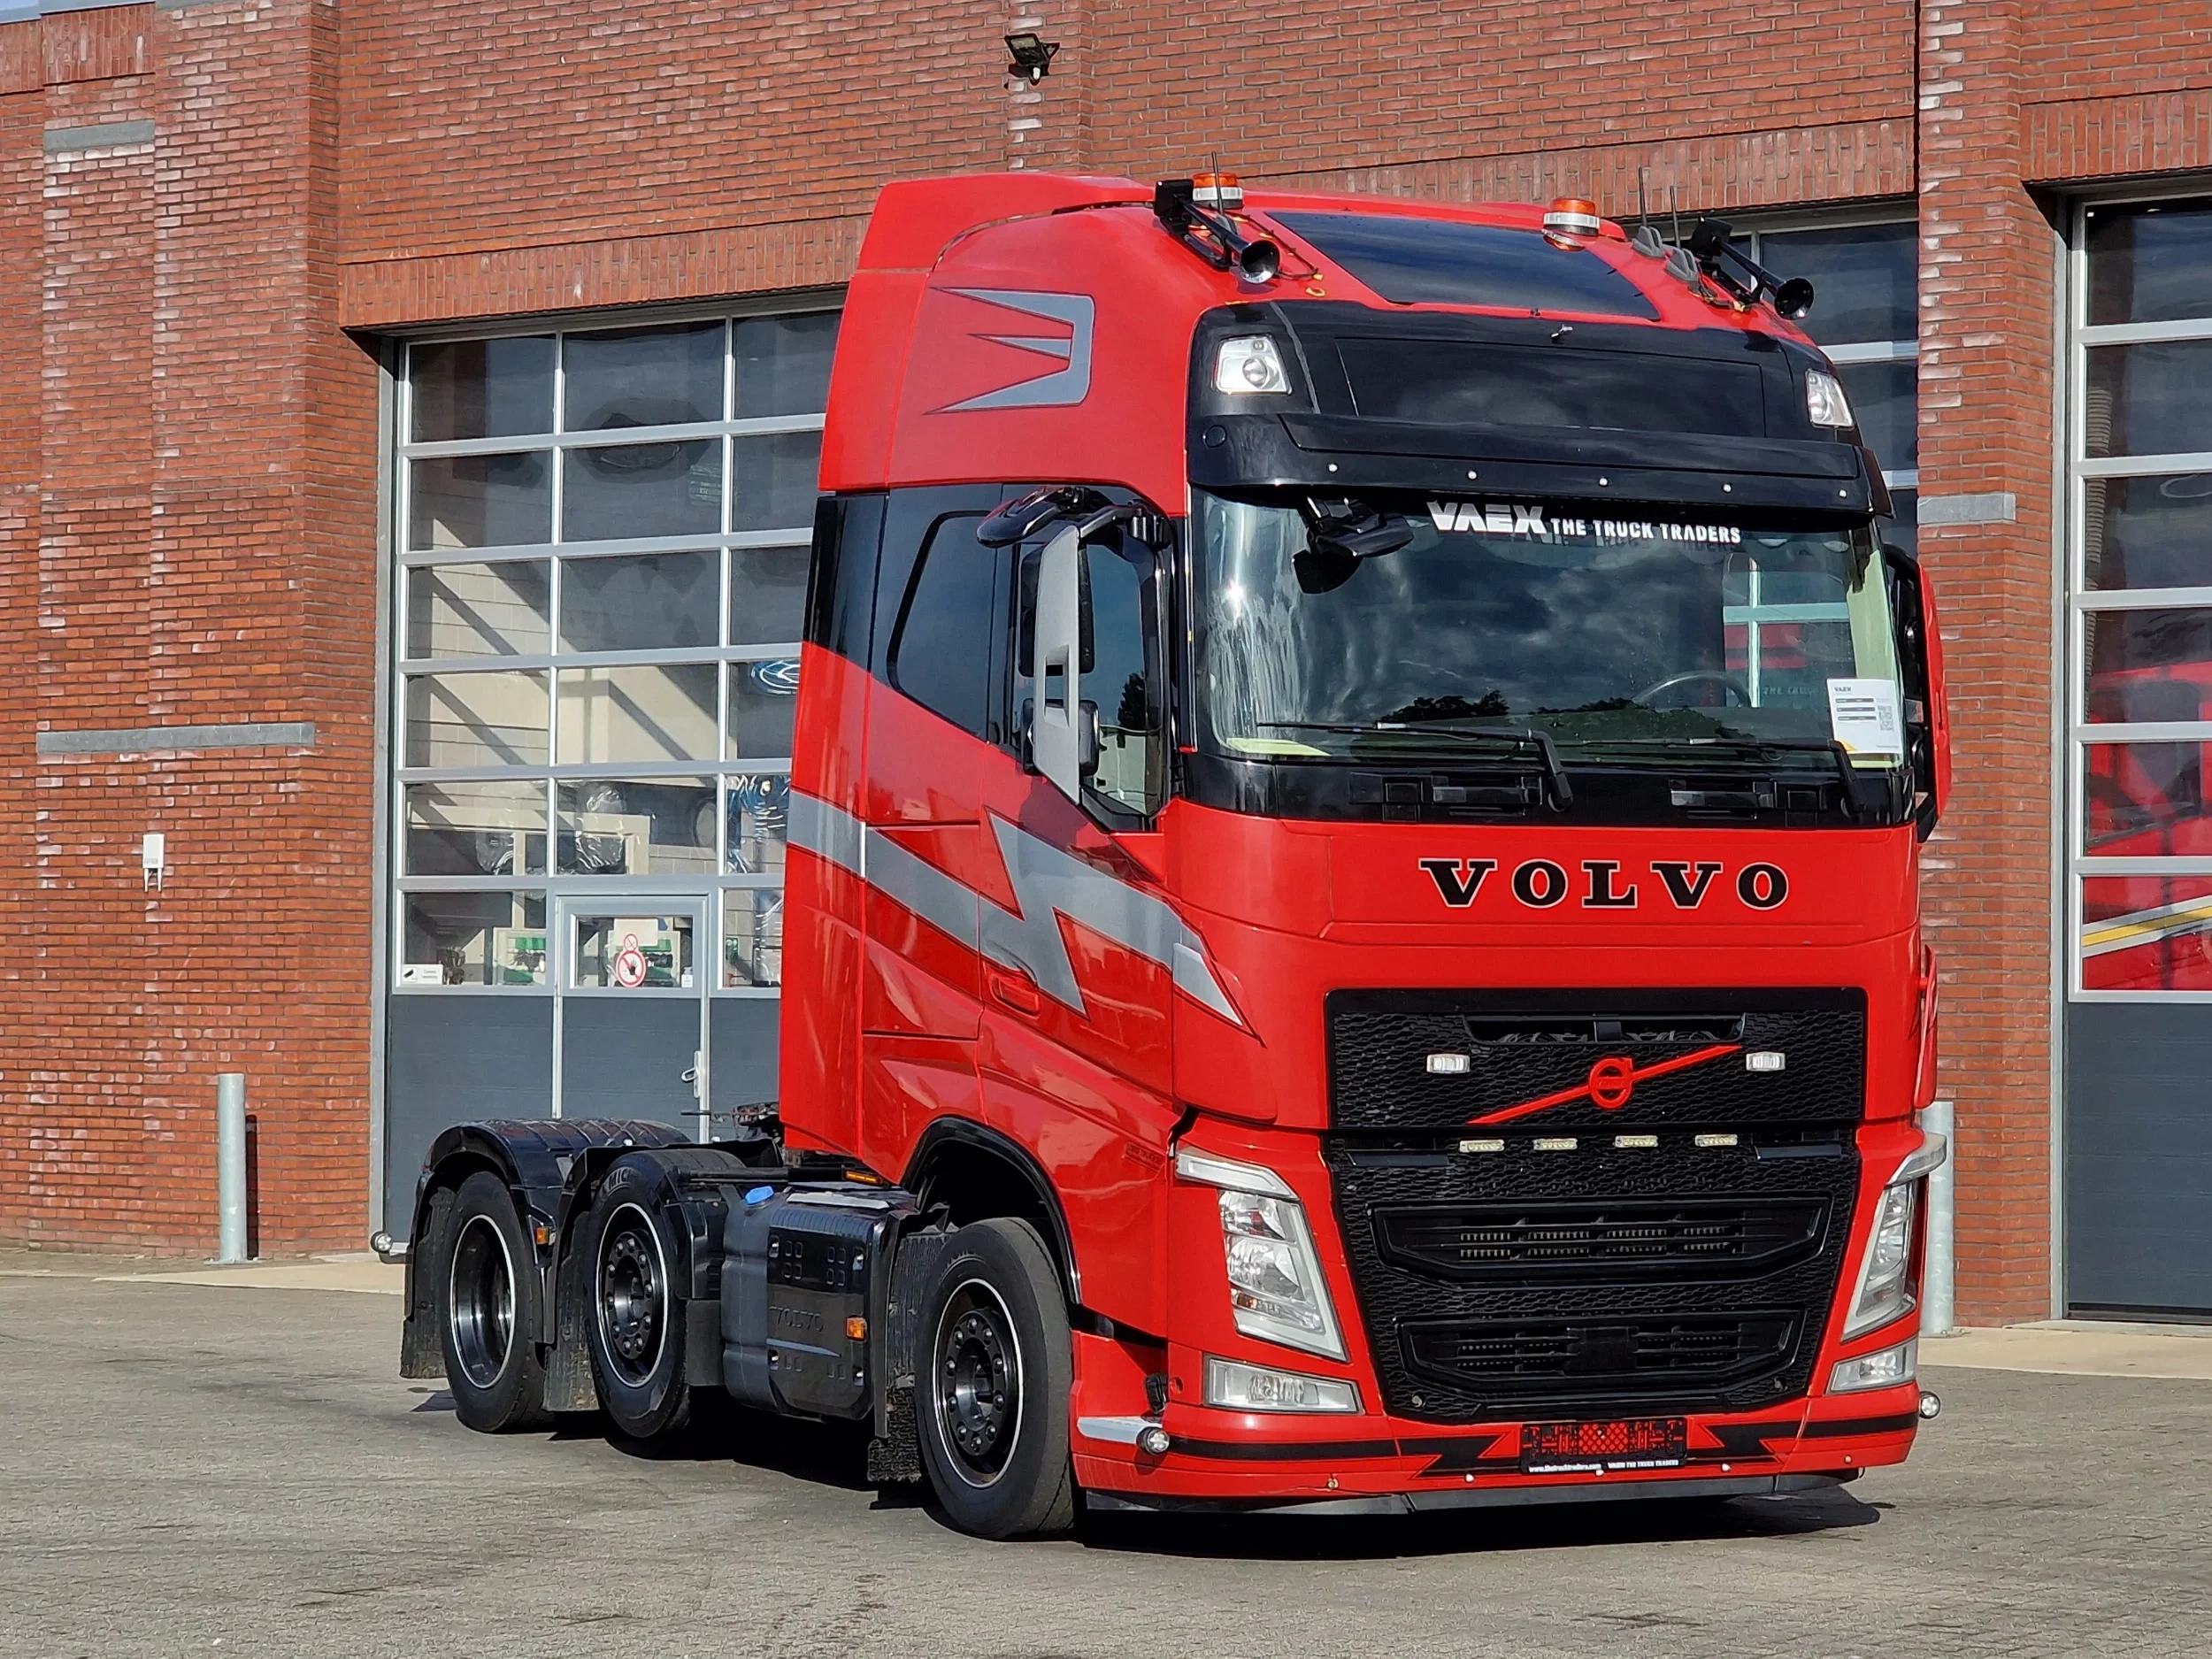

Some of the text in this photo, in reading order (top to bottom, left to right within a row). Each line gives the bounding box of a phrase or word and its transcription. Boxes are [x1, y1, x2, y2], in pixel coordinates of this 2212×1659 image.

[1426, 500, 1741, 543] VAEX THE TRUCK TRADERS
[1418, 857, 1789, 910] VOLVO
